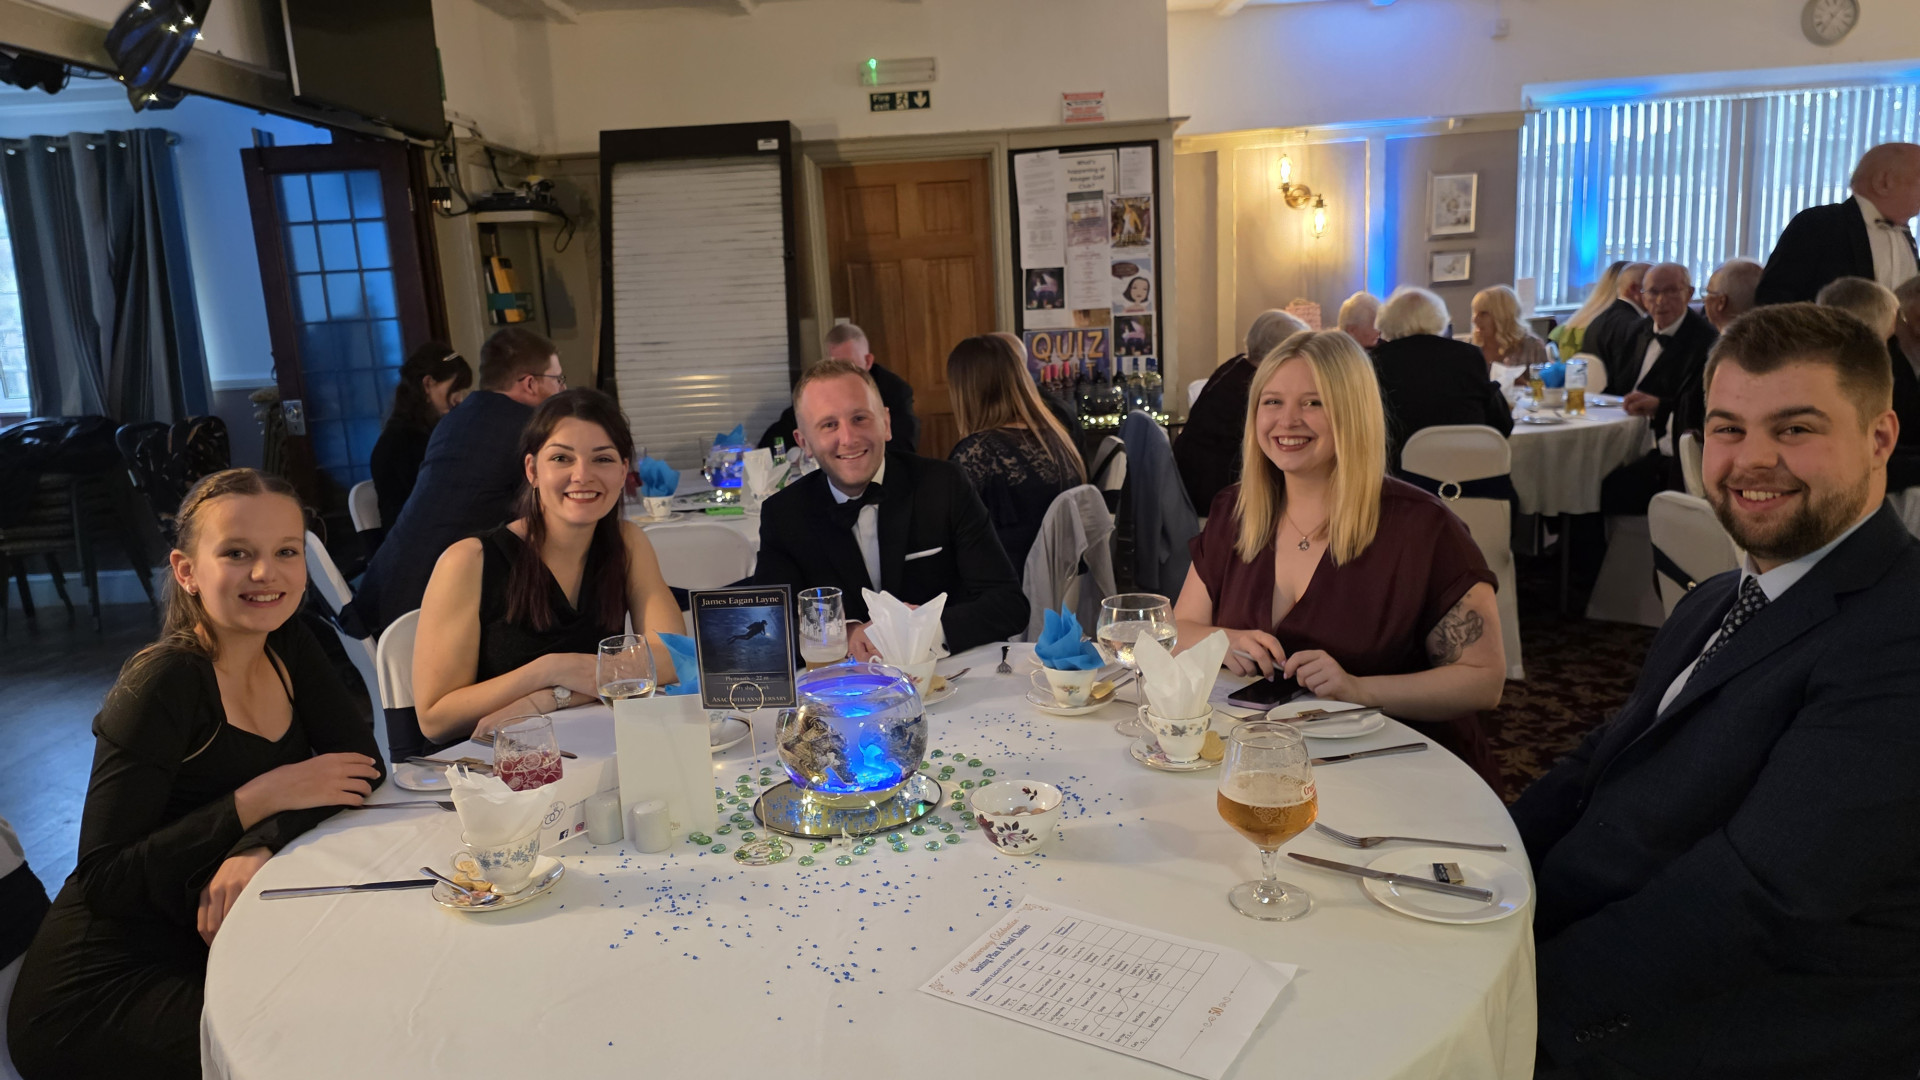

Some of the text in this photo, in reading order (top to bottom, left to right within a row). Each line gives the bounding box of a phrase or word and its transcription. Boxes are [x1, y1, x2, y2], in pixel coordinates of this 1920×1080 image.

[1032, 331, 1103, 362] QUIZ
[701, 596, 779, 606] James Eagan Layne
[990, 919, 1019, 940] Celebration
[970, 958, 994, 973] Seating
[986, 950, 1001, 960] Plan
[1000, 936, 1016, 948] Meal
[1011, 924, 1031, 938] Choices
[1208, 1007, 1224, 1016] 50
